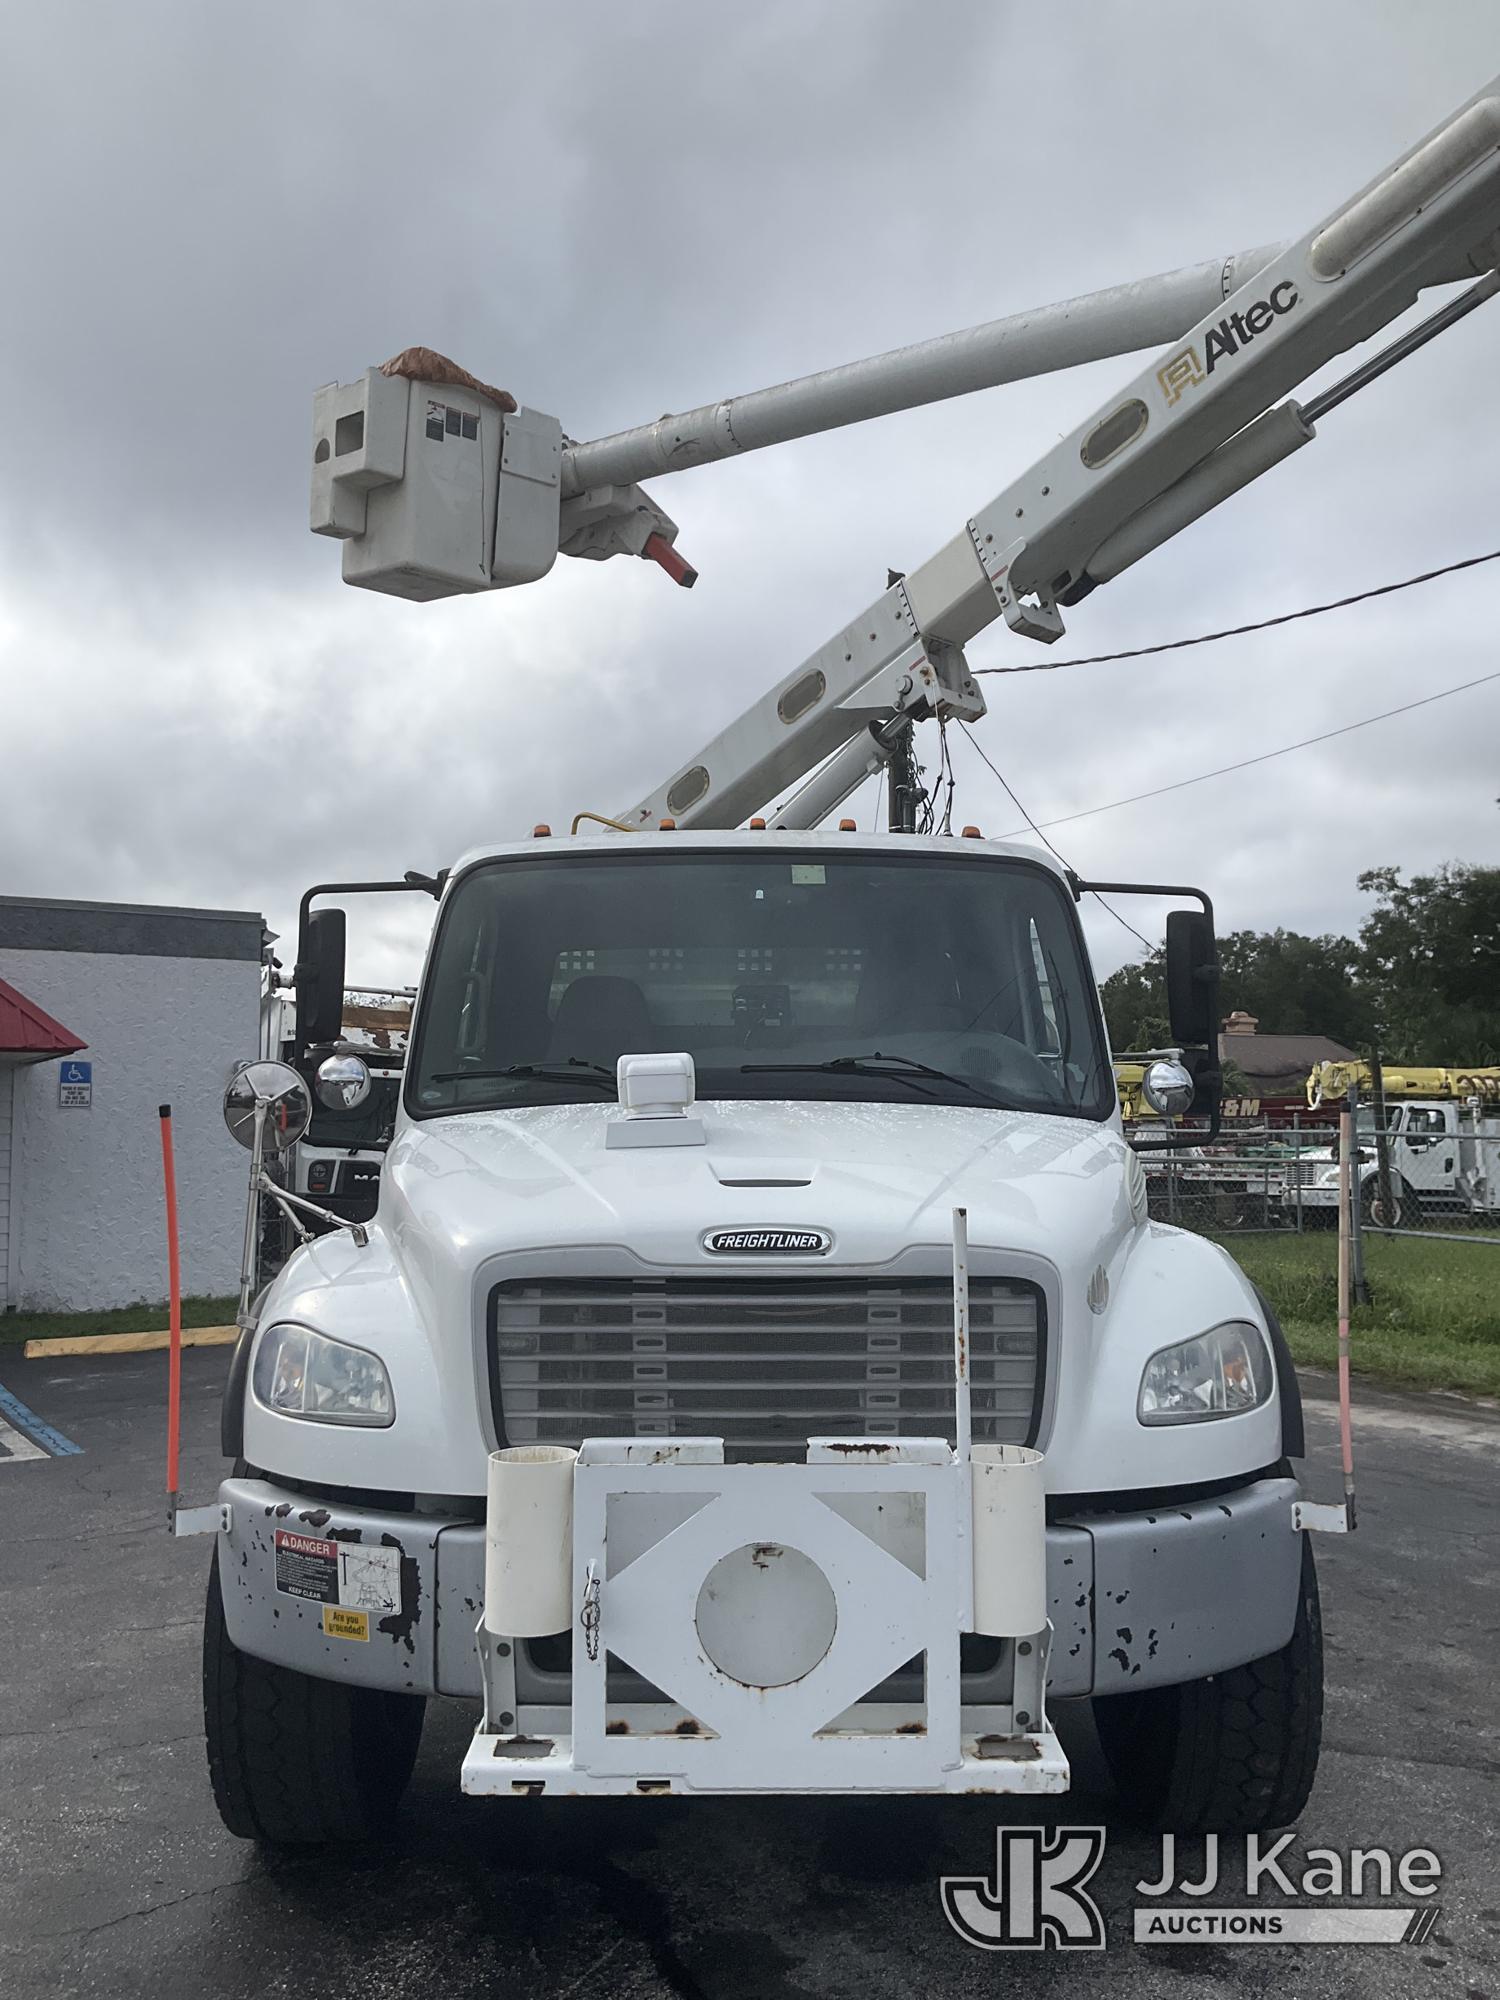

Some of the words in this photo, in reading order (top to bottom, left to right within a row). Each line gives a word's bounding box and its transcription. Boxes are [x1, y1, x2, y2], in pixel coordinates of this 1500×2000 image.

[1205, 281, 1298, 375] Altec
[716, 1234, 818, 1248] FREIGHTLINER
[290, 1537, 330, 1555] DANGER
[288, 1586, 302, 1595] KEEP
[302, 1590, 321, 1599] CLEAR
[333, 1612, 345, 1621] Are
[346, 1615, 359, 1625] you
